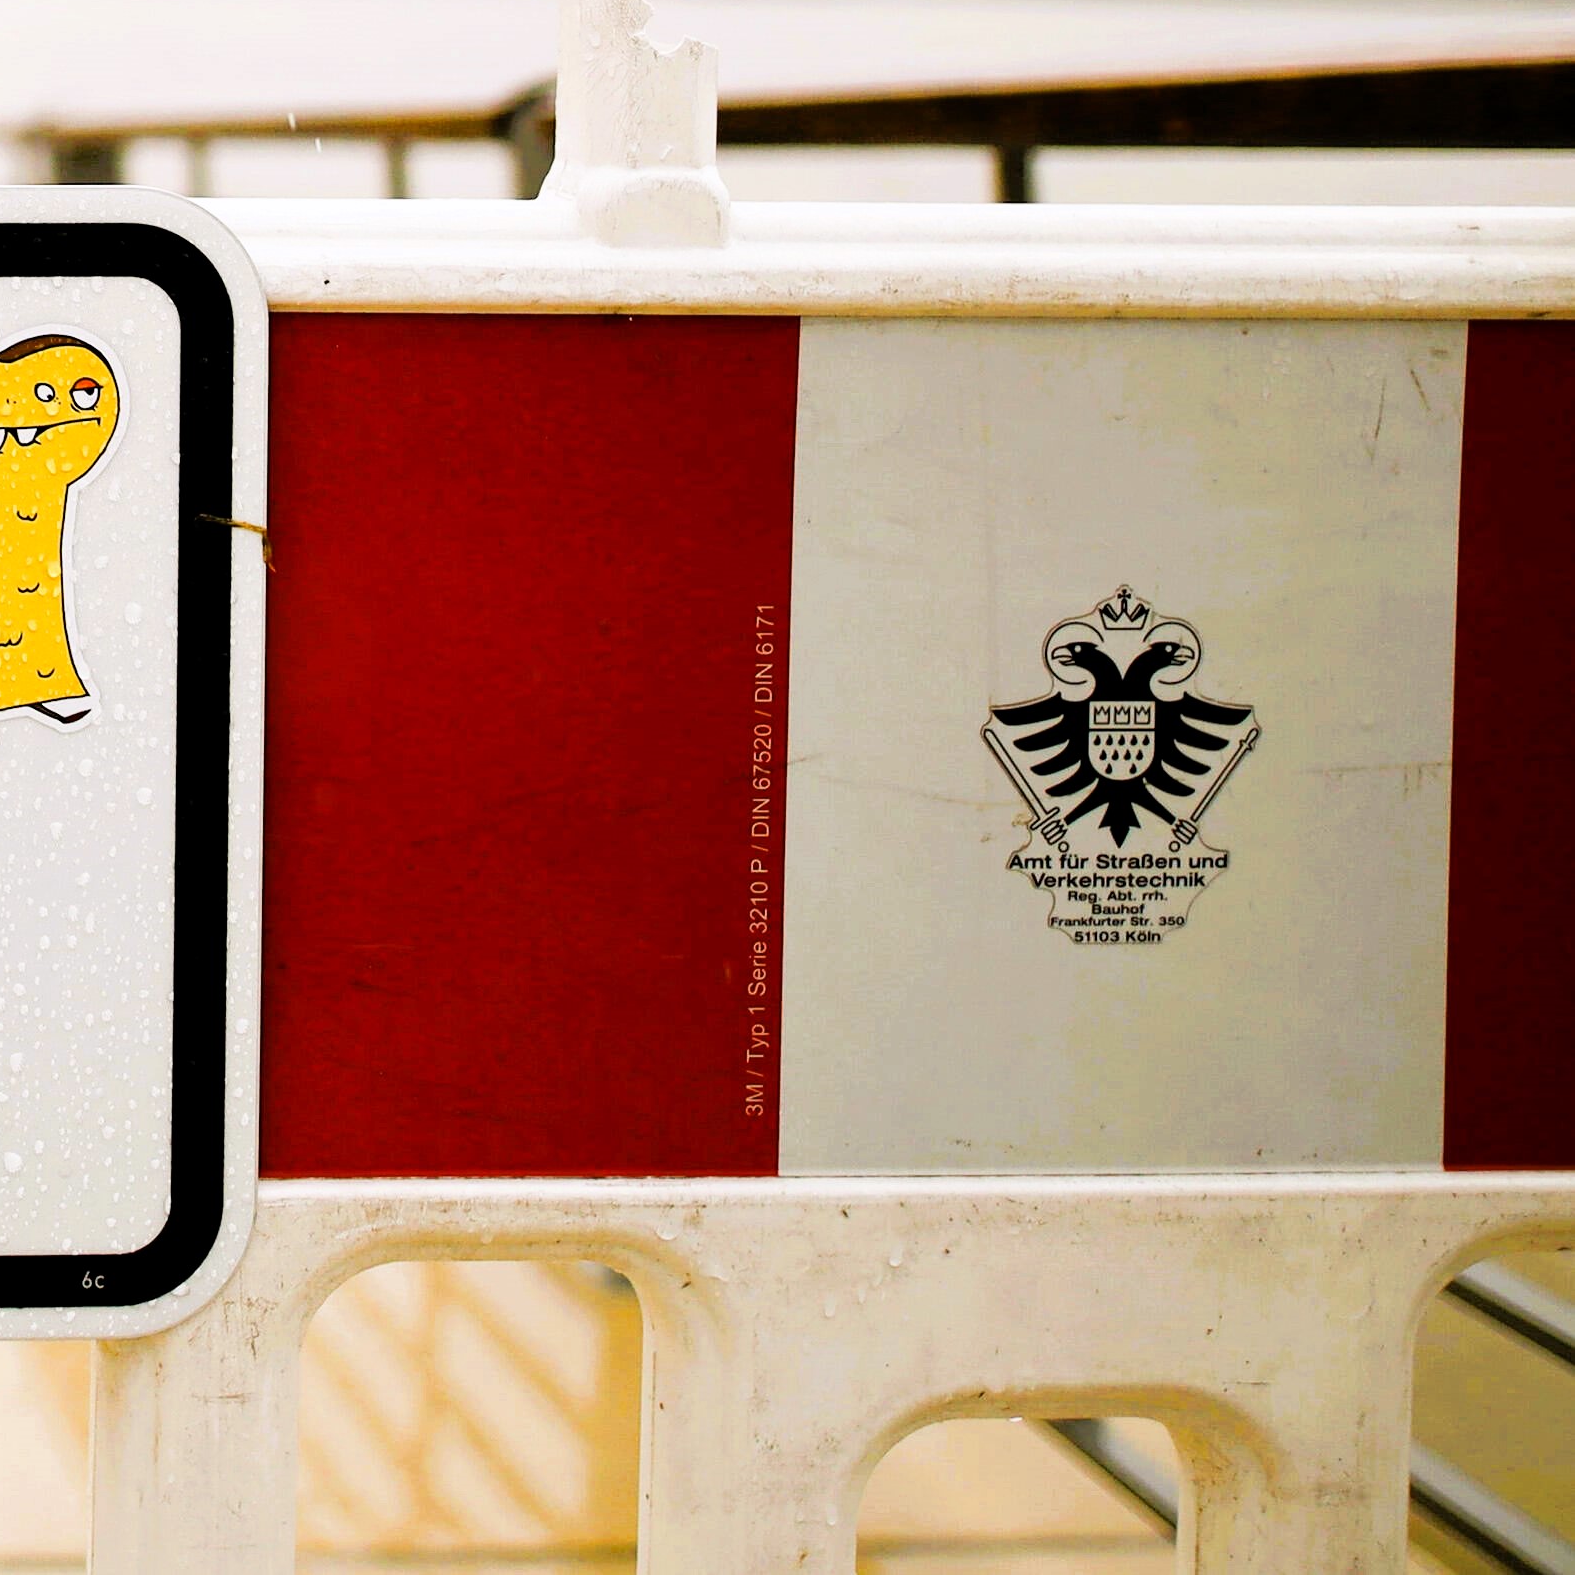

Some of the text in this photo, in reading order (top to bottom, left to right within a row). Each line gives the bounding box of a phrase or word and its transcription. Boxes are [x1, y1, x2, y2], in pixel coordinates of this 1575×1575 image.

[755, 605, 775, 656] 6171
[754, 663, 774, 703] DIN
[752, 724, 772, 790] 67520
[751, 798, 771, 838] DIN
[750, 858, 769, 874] P
[1009, 853, 1228, 869] Amt für Straßen und
[1031, 872, 1206, 888] Verkehrstechnik
[748, 881, 769, 934] 3210
[1068, 891, 1168, 903] Reg. Abt. rrh.
[1050, 916, 1185, 926] Frankfurter Str. 350
[1091, 904, 1145, 915] Bauhof
[1074, 931, 1161, 942] 51103 Köln
[747, 941, 767, 997] Serie
[747, 1007, 766, 1015] 1
[746, 1023, 770, 1064] Typ
[745, 1084, 764, 1116] 3M
